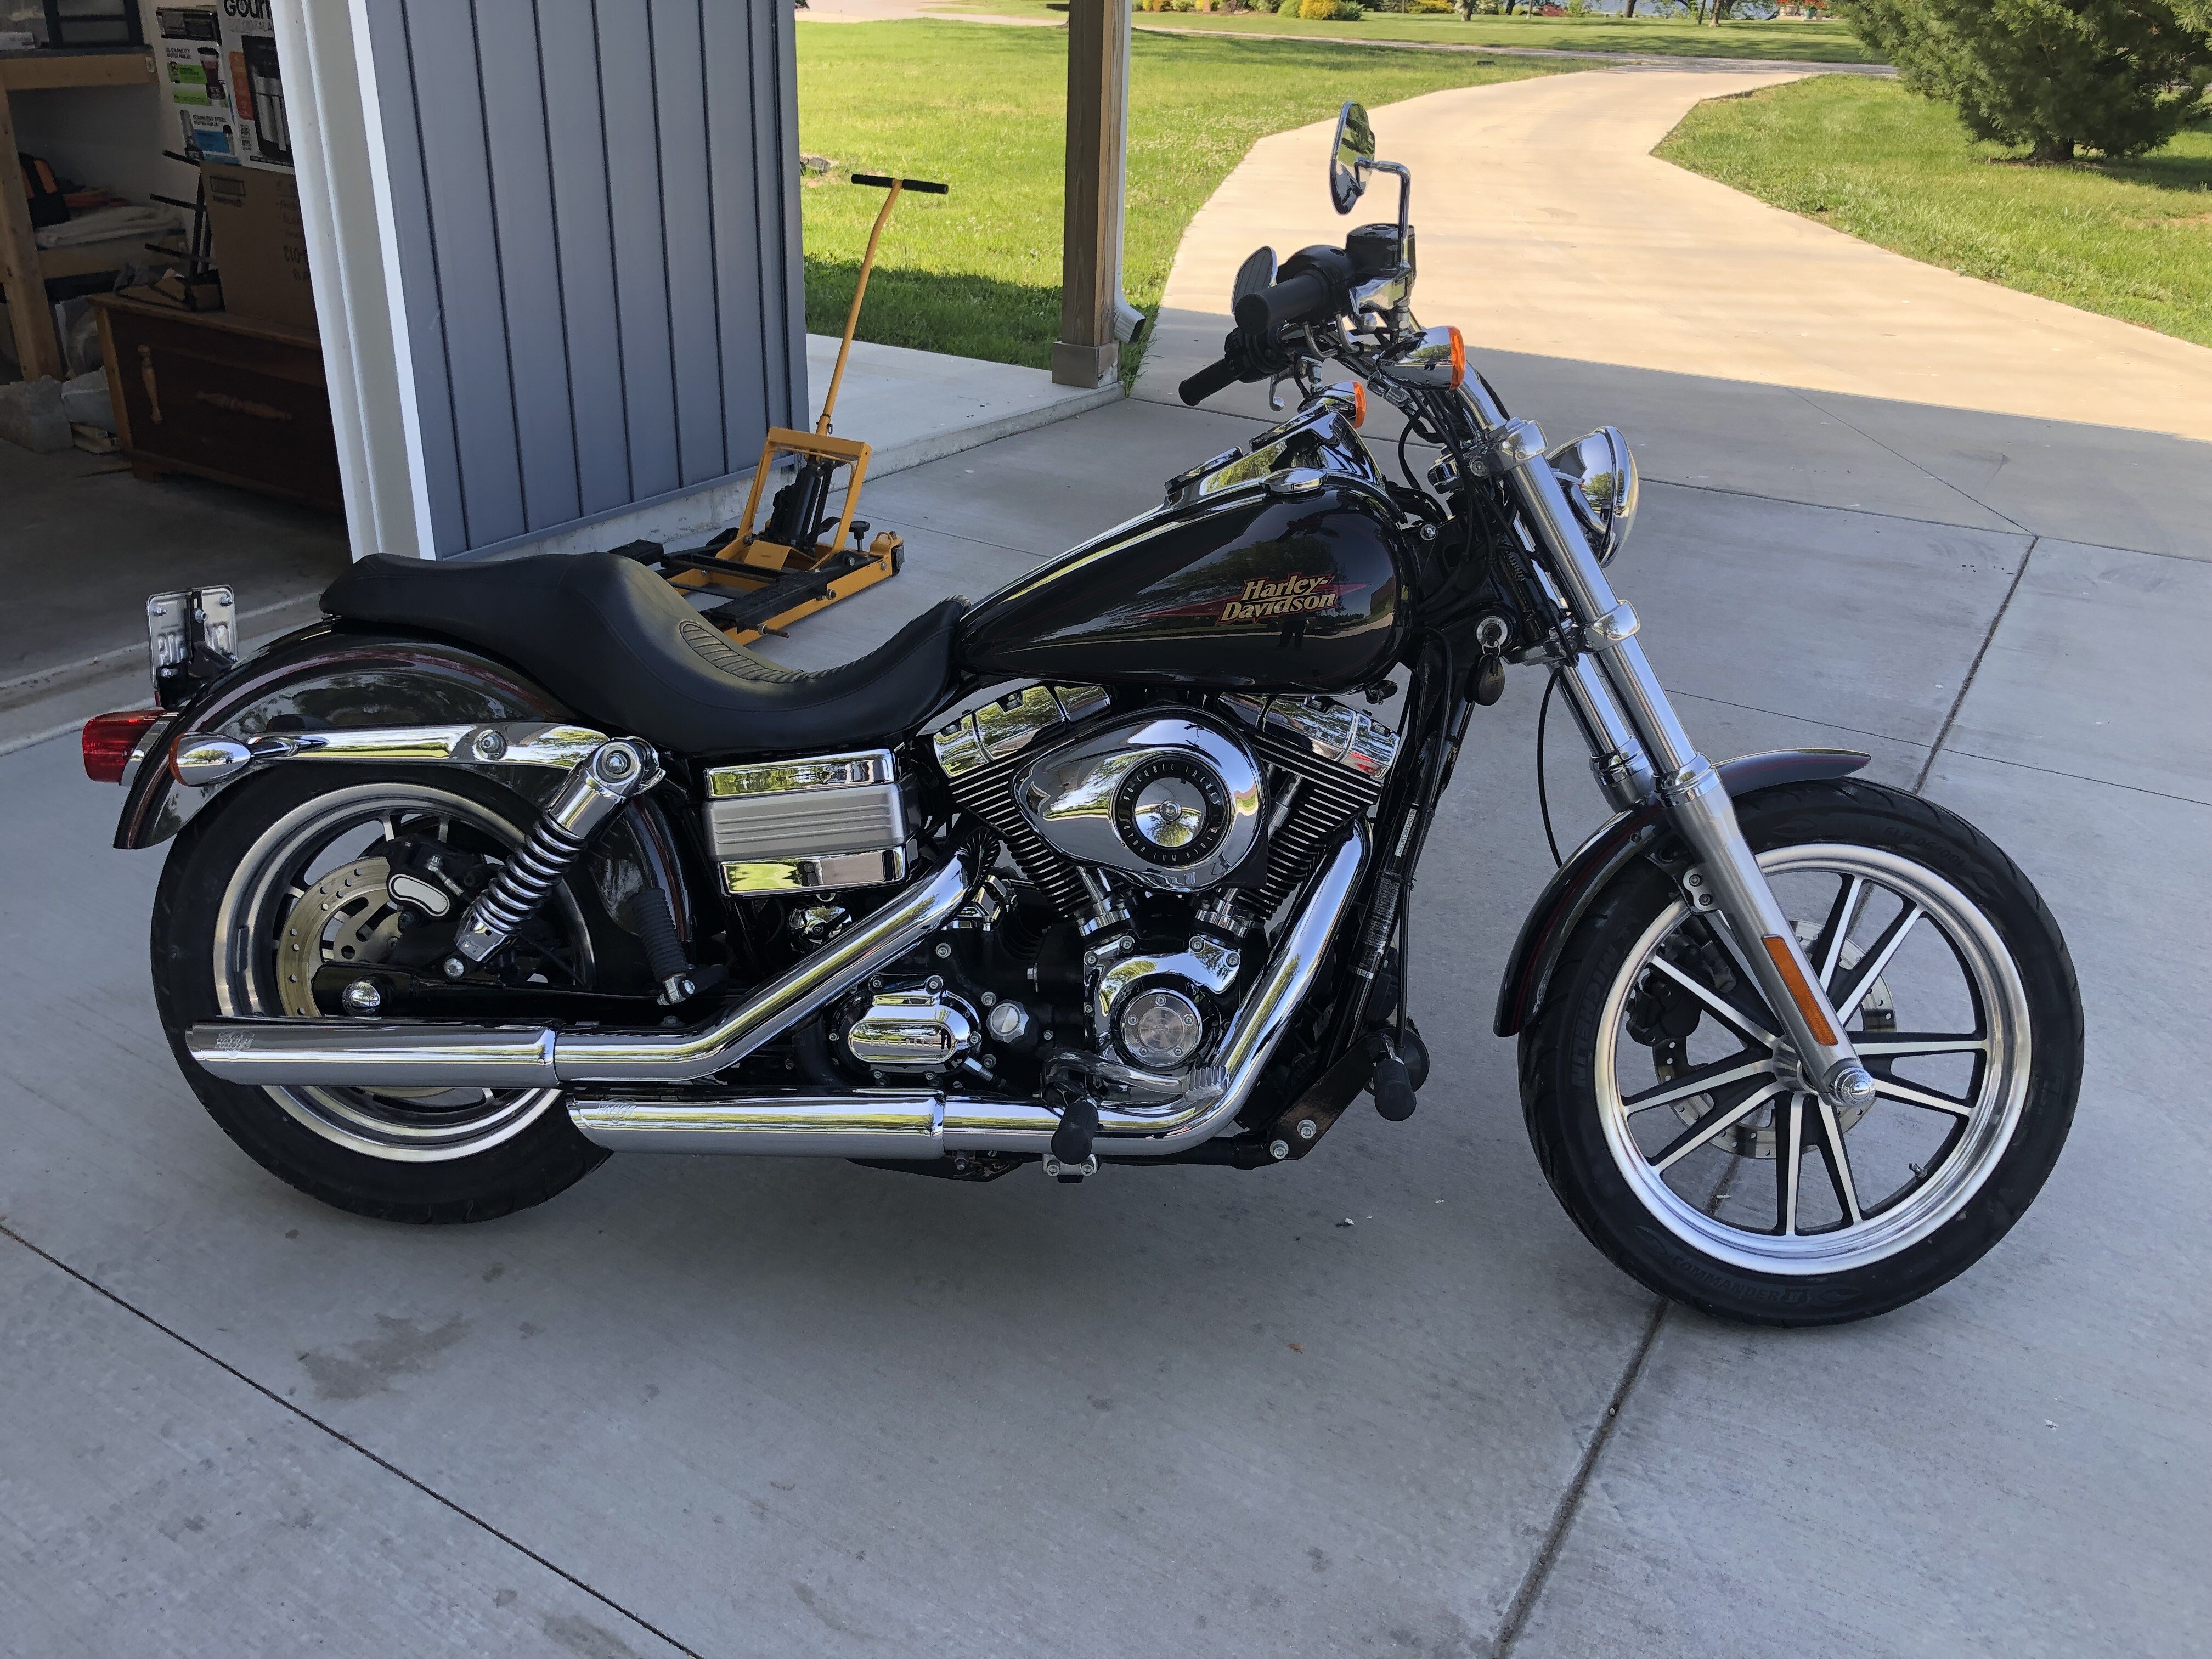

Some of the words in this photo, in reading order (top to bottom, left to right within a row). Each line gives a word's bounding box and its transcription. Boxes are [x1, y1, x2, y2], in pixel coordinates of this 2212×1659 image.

[1240, 575, 1330, 601] Harley-
[1221, 593, 1335, 621] Davidson
[1136, 763, 1175, 783] CUBIC
[1185, 766, 1220, 804] INCHES
[1153, 852, 1177, 862] LOW
[1186, 826, 1218, 859] RIDER
